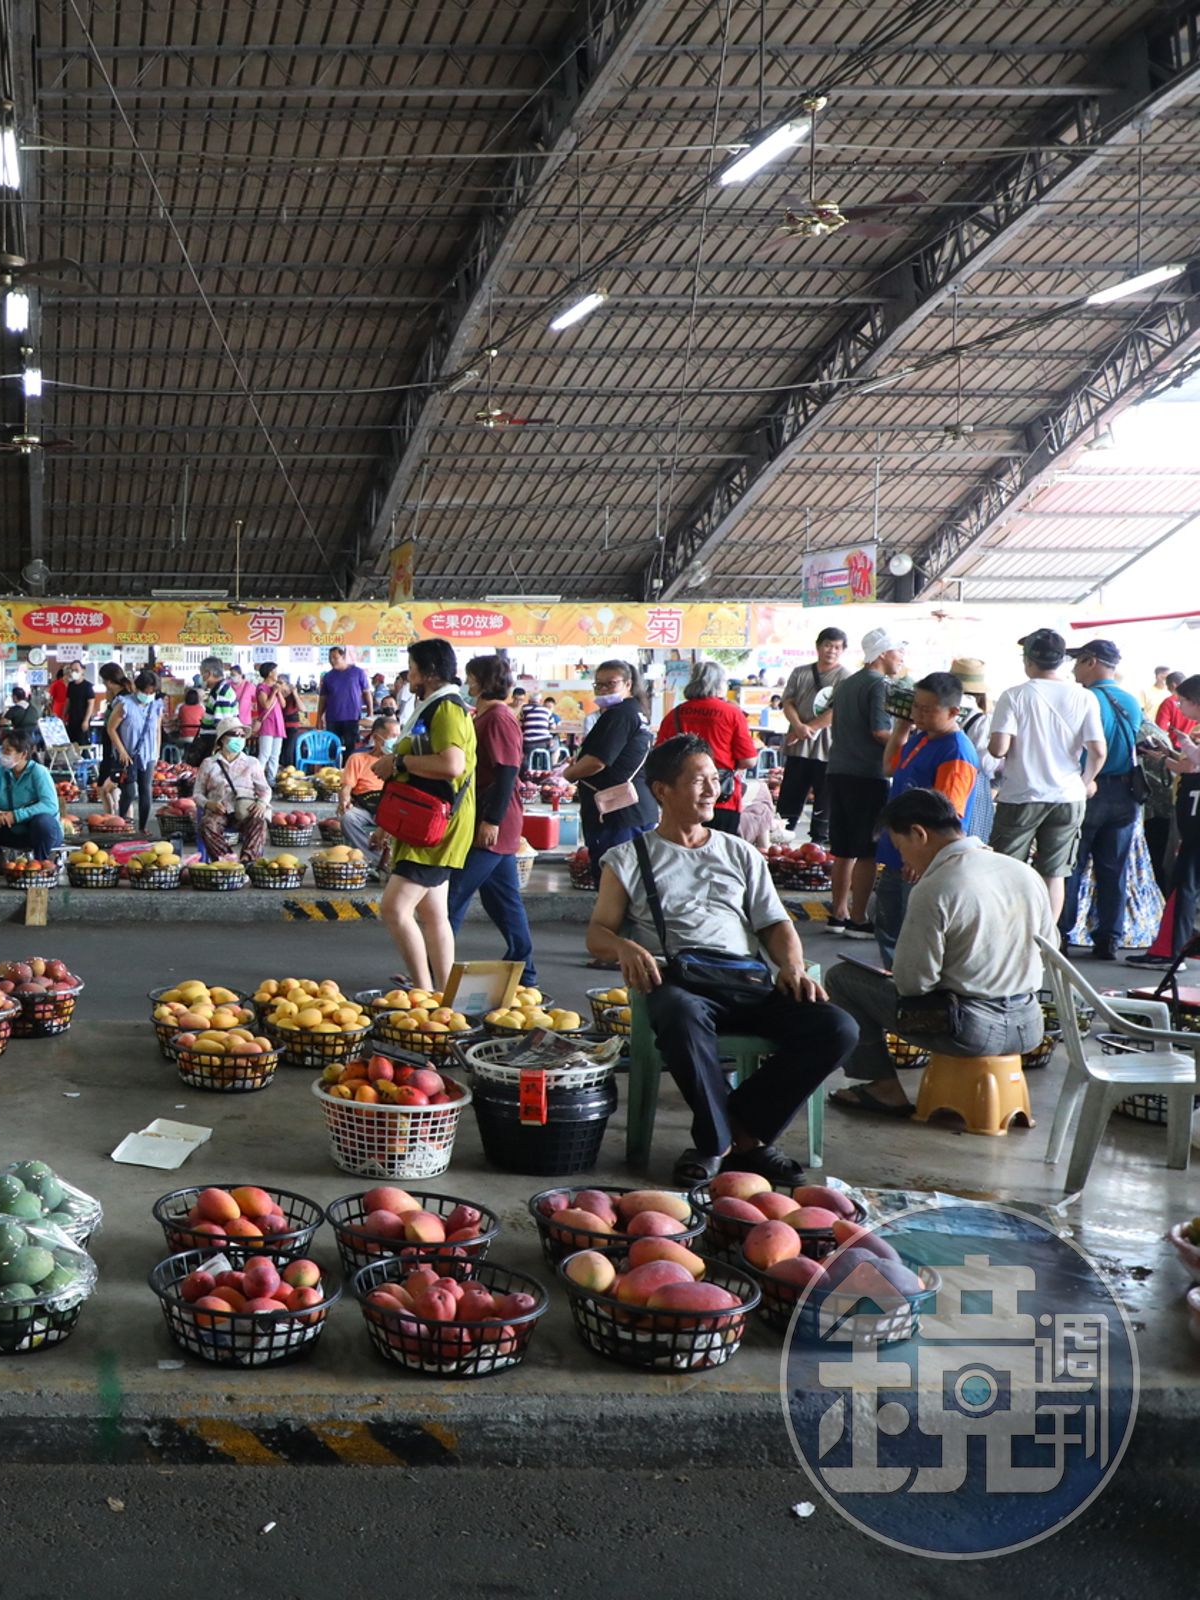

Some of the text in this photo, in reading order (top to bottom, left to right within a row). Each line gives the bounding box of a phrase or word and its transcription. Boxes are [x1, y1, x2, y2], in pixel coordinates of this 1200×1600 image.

[30, 611, 105, 627] 芒果の故鄉
[249, 606, 285, 643] 菊
[430, 614, 505, 629] 芒果の故鄉
[647, 608, 683, 644] 菊
